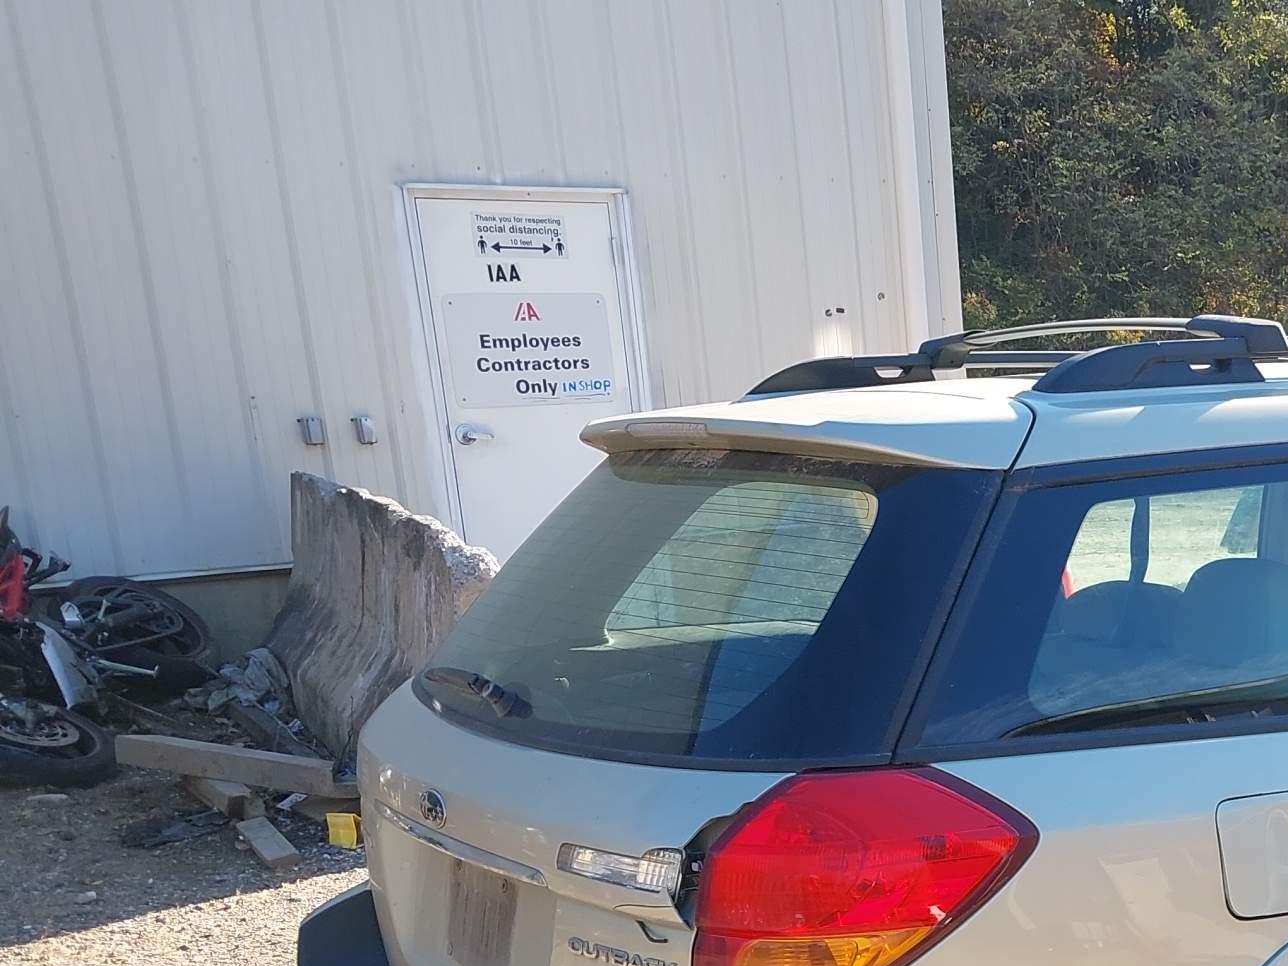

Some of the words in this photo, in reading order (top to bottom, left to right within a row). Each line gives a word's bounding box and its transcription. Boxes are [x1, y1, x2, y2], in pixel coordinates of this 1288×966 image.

[475, 214, 496, 222] Thank
[524, 217, 561, 226] respecting
[477, 224, 506, 233] social
[487, 264, 521, 282] IAA
[480, 333, 581, 352] Employees
[476, 357, 590, 373] Contractors
[516, 379, 558, 397] Only
[562, 381, 577, 392] IN
[578, 379, 611, 392] SHOP
